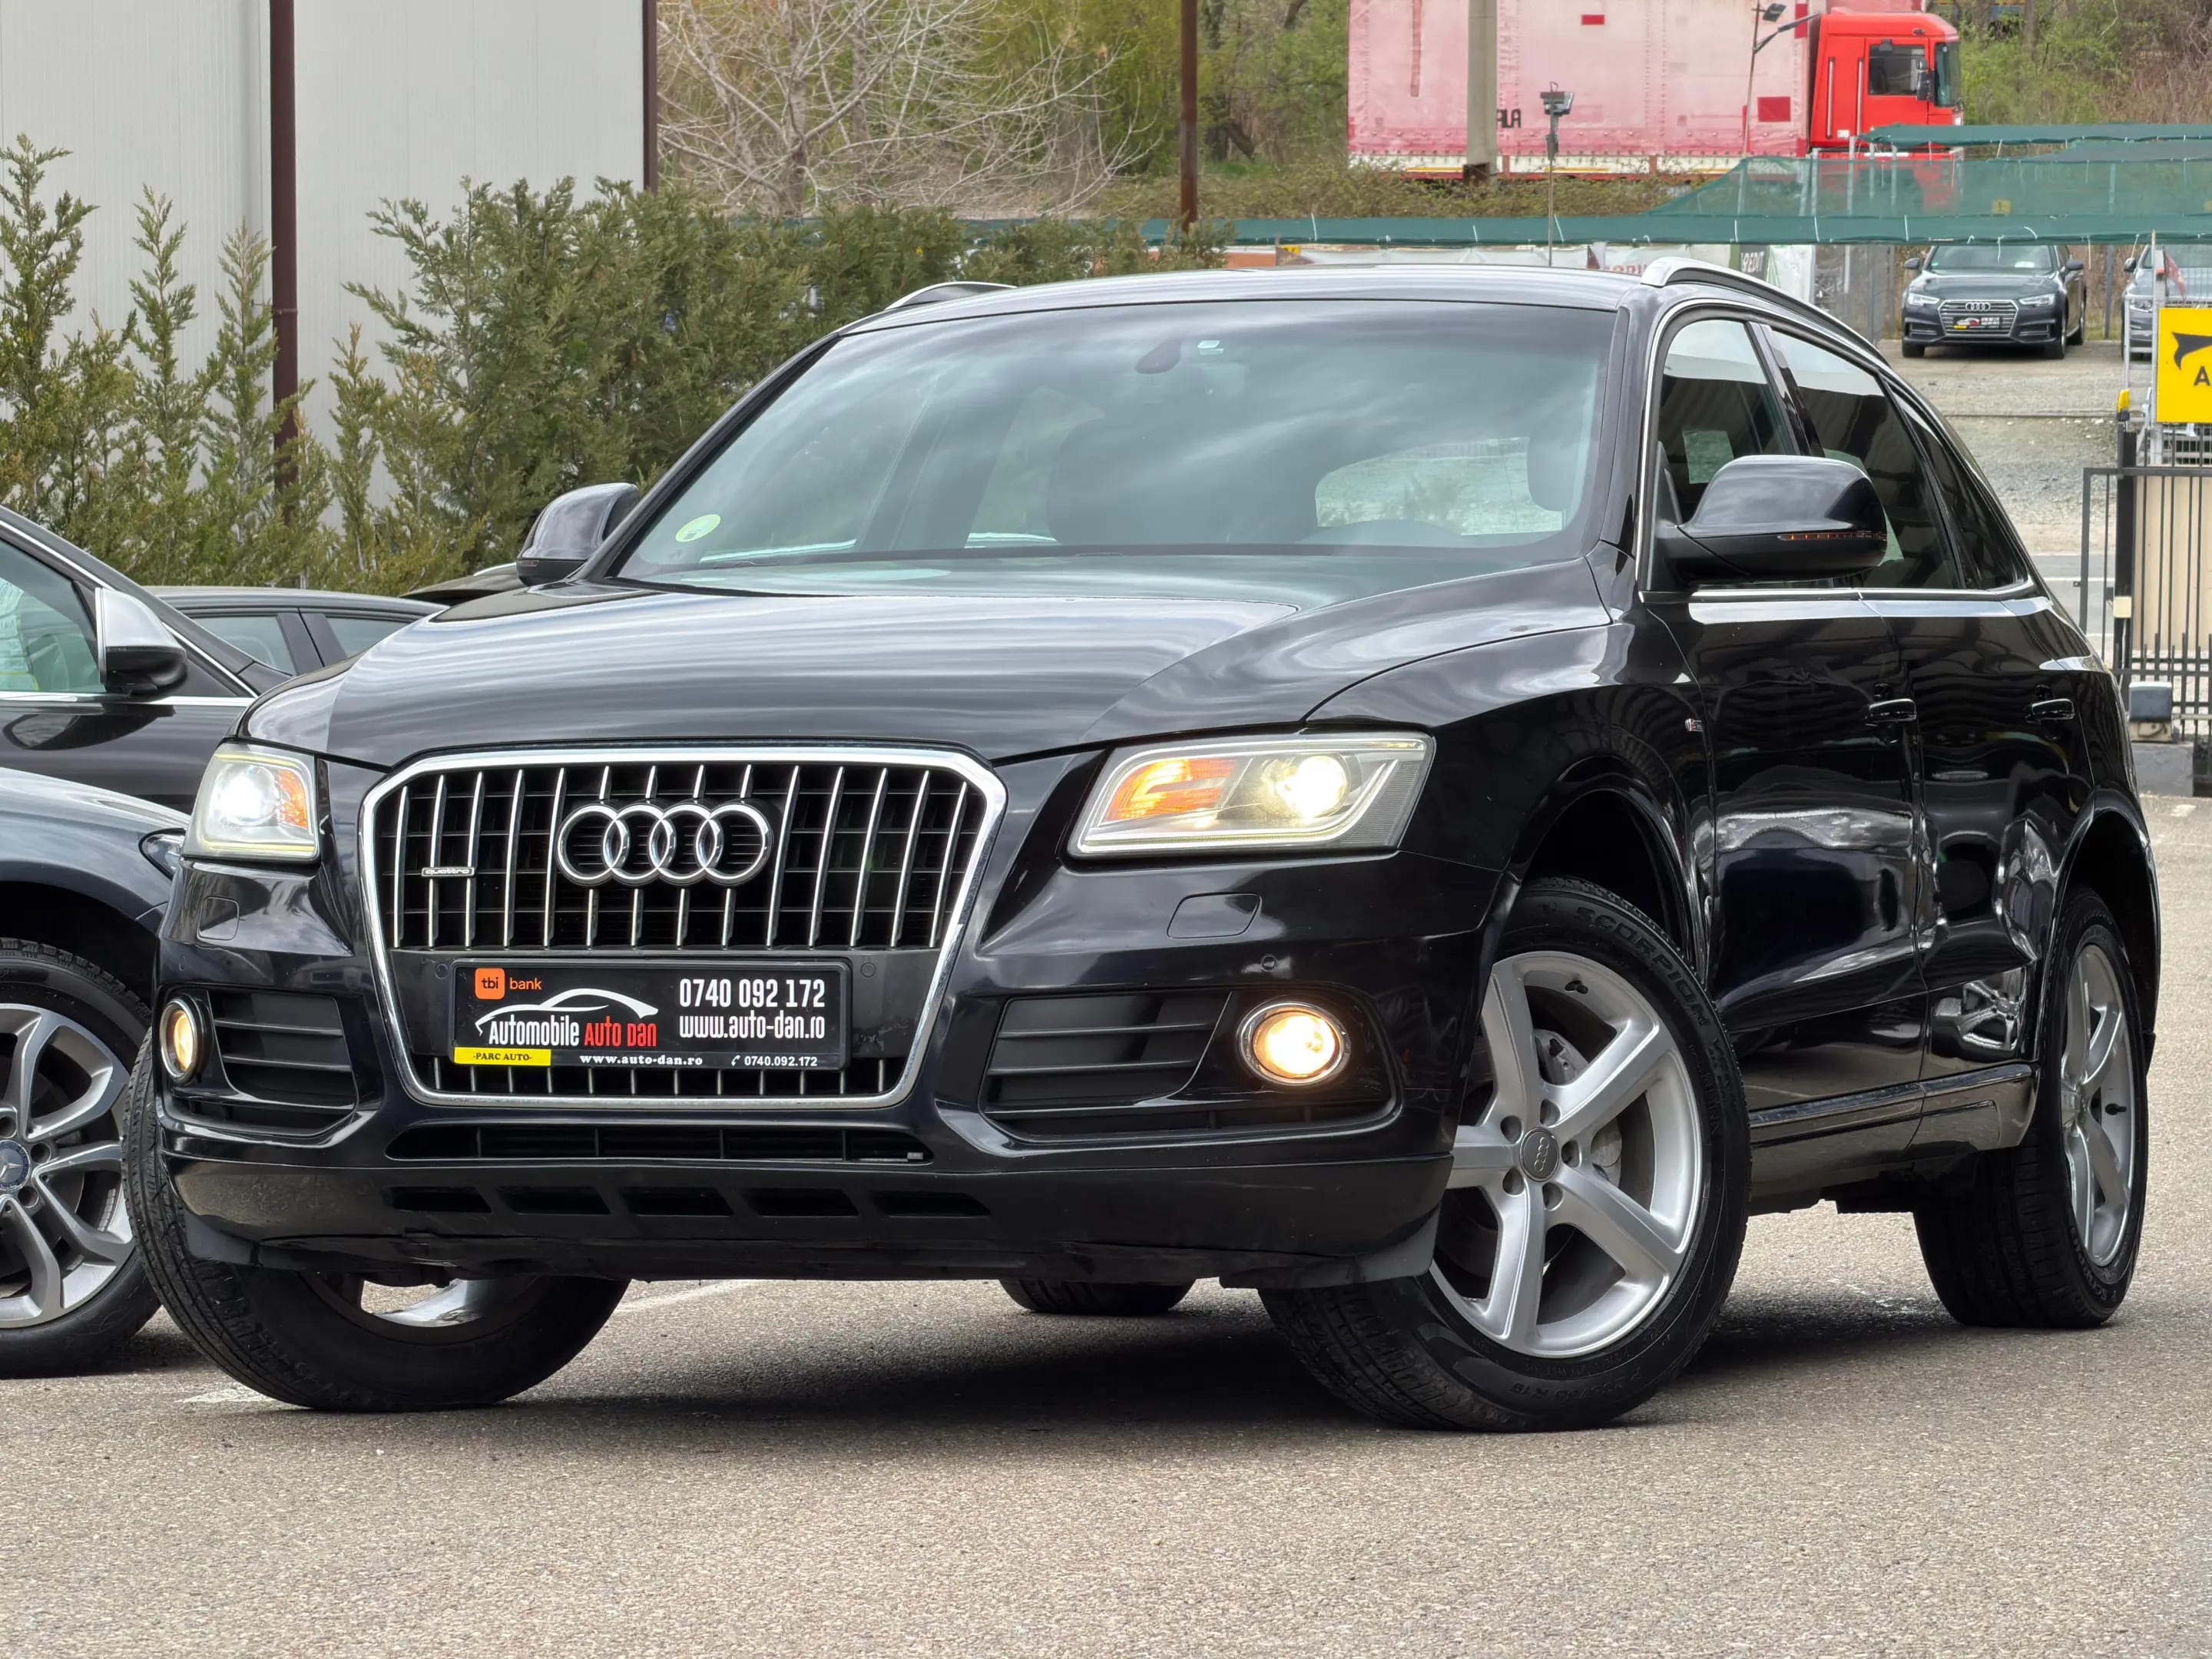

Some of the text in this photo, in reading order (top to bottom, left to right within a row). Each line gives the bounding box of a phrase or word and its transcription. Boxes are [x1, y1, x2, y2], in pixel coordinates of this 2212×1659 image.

[482, 977, 542, 990] tbi bank
[679, 979, 826, 1008] 0740 092 172
[488, 1014, 580, 1046] Automobile
[679, 1009, 826, 1039] www.auto-dan.ro
[579, 1055, 704, 1065] www.auto-dan.ro
[744, 1055, 818, 1067] 0740.092.172
